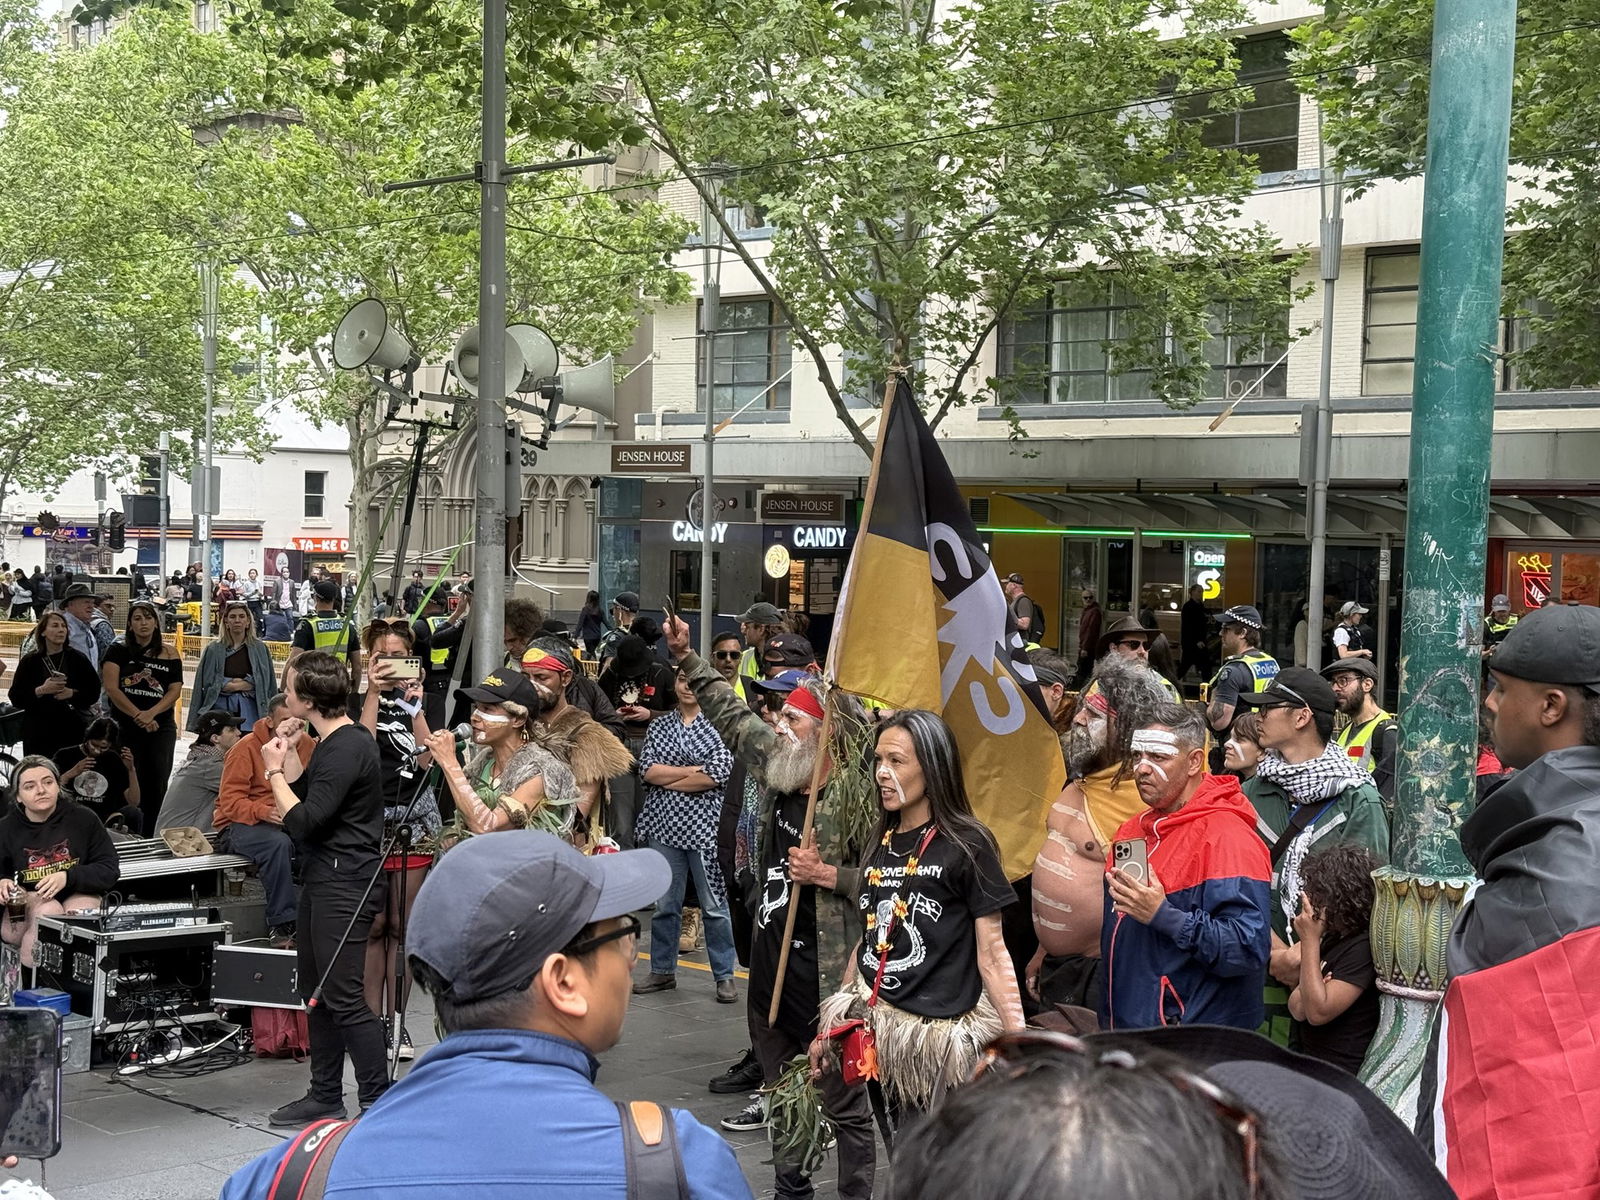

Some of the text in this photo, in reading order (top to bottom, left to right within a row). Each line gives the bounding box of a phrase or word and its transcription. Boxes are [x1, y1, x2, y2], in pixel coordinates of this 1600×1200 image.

[616, 451, 685, 462] JENSEN HOUSE
[765, 500, 834, 511] JENSEN HOUSE
[793, 527, 847, 547] CANDY
[299, 540, 337, 551] TA-KE
[1193, 551, 1225, 564] Open
[1254, 663, 1280, 676] Police
